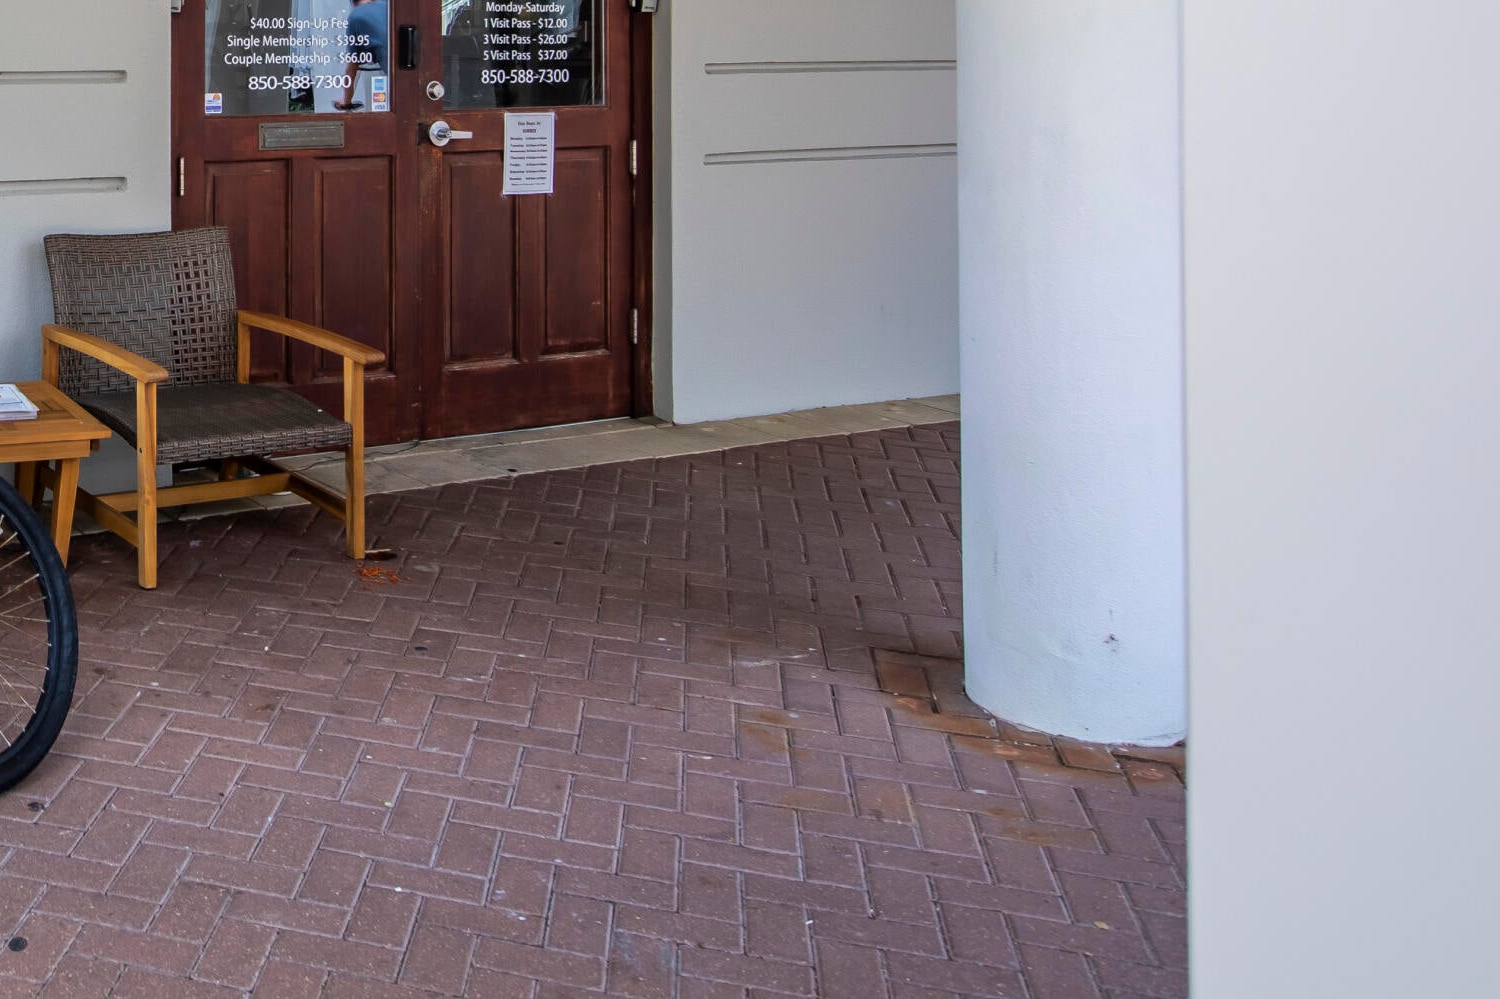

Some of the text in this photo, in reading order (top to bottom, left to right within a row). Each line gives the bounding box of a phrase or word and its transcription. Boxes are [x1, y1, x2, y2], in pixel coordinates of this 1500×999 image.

[485, 1, 565, 14] Monday-Saturday
[250, 17, 349, 32] $40.00 Sign-Up Fee
[483, 18, 489, 28] 1
[490, 18, 510, 28] Visit
[511, 18, 531, 28] Pass
[538, 18, 568, 28] $12.00
[227, 35, 260, 49] Single
[262, 35, 328, 49] Membership
[336, 35, 370, 47] $39.95
[483, 34, 489, 44] 3
[490, 34, 510, 44] Visit
[511, 34, 531, 44] Pass
[538, 34, 568, 44] $26.00
[224, 53, 263, 67] Couple
[264, 53, 331, 67] Membership
[339, 52, 373, 64] $66.00
[483, 50, 568, 60] 5 Visit Pass $37.00
[248, 74, 352, 90] 850-588-7300
[481, 69, 570, 84] 850-588-7300
